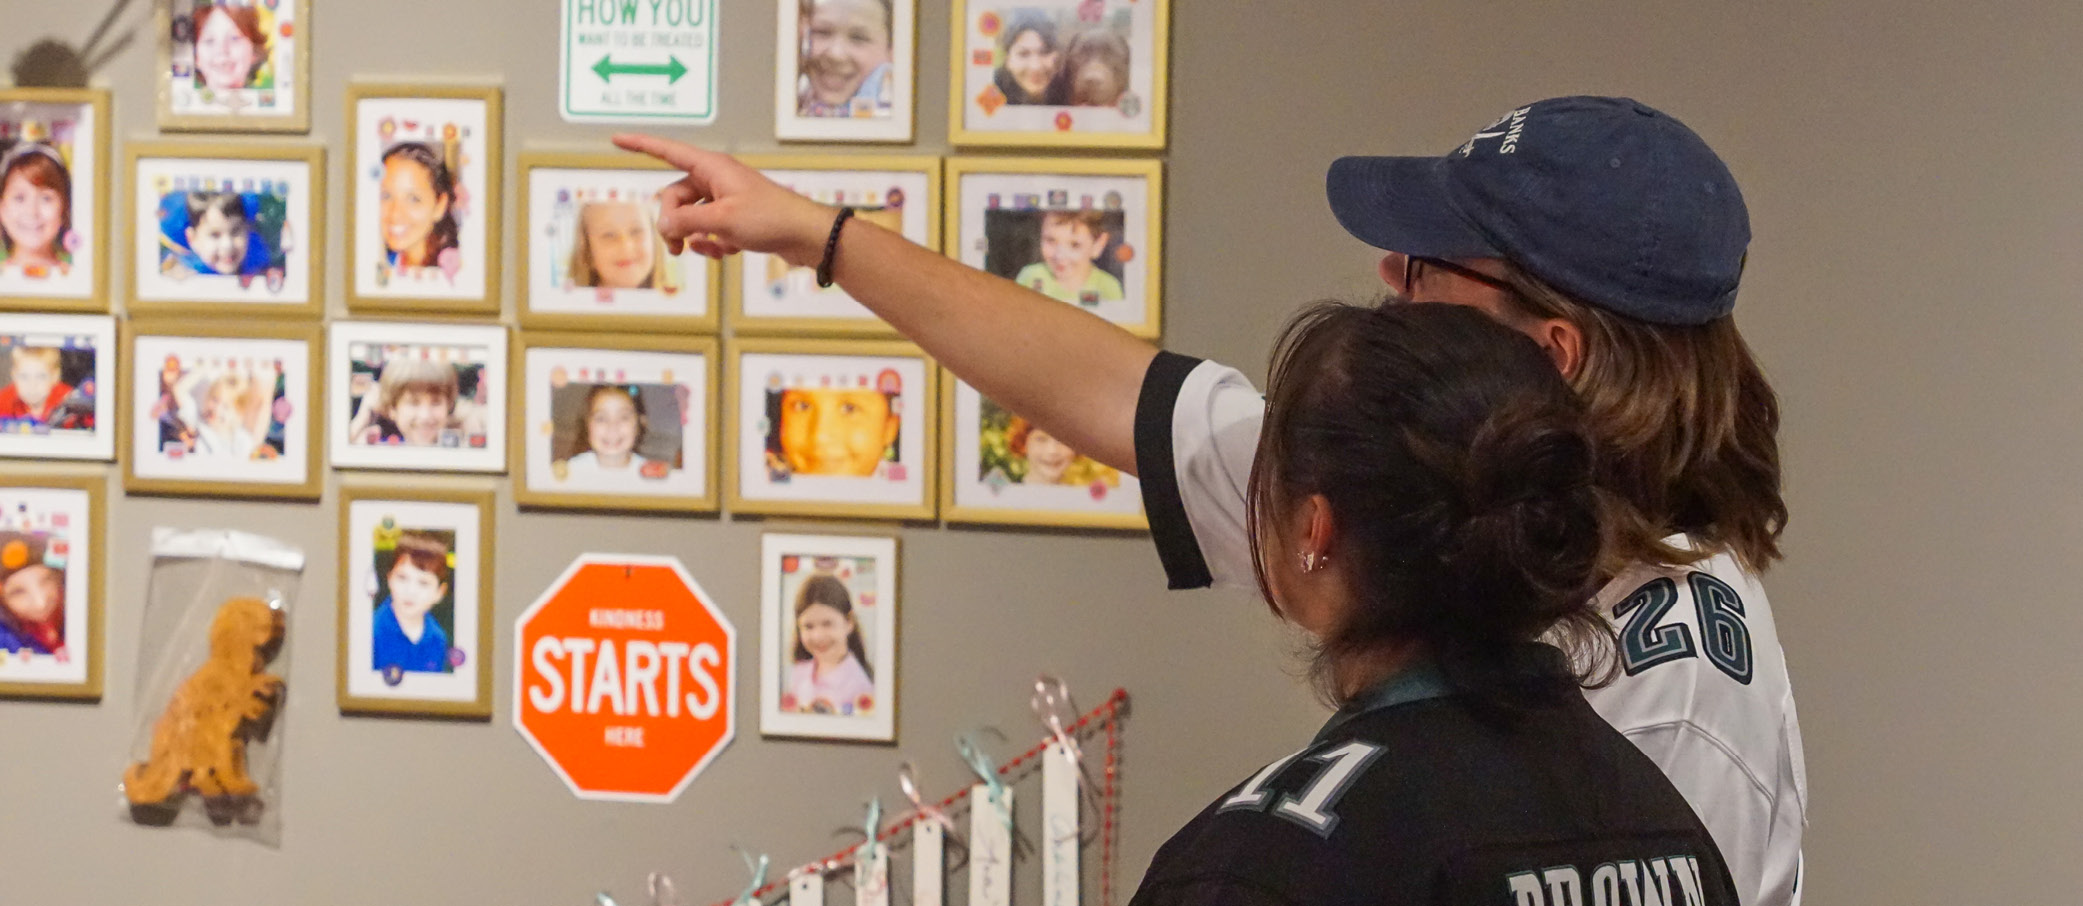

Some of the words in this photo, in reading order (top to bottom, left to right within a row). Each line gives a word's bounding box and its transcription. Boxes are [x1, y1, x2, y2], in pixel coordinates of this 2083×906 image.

[578, 0, 638, 25] HOW
[649, 0, 704, 27] YOU
[589, 607, 664, 631] KINDNESS
[1612, 571, 1753, 685] 26
[529, 635, 720, 720] STARTS
[604, 726, 645, 748] HERE
[1214, 739, 1389, 840] 11
